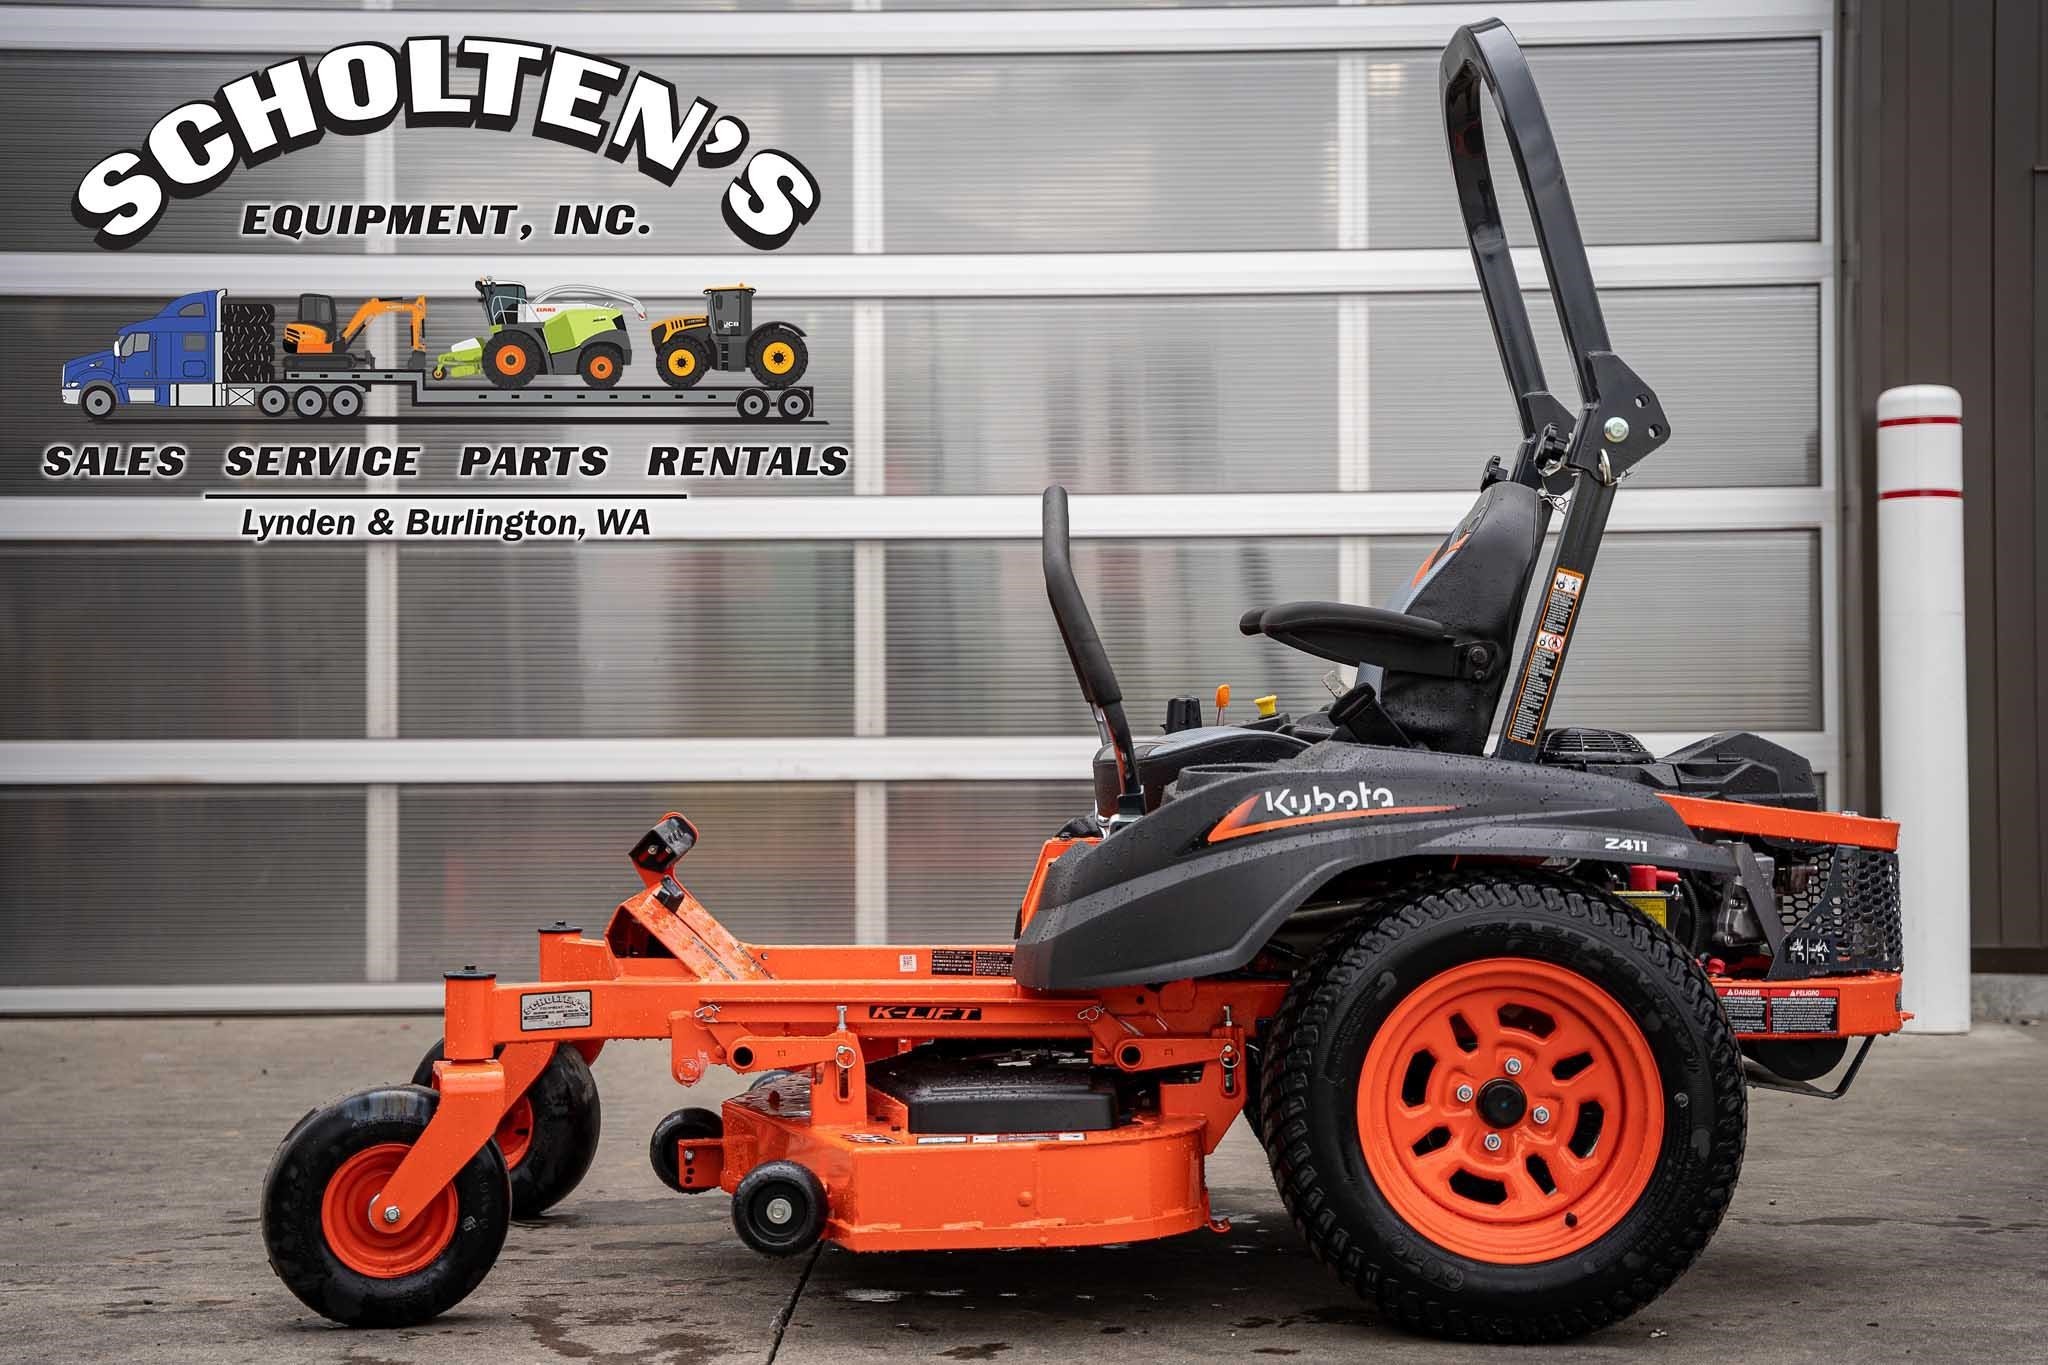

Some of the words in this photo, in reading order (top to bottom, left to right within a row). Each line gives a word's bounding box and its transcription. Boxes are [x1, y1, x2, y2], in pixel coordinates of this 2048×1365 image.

[1265, 781, 1394, 816] Kubota
[1604, 837, 1648, 852] Z411
[872, 1006, 978, 1020] K-LIFT
